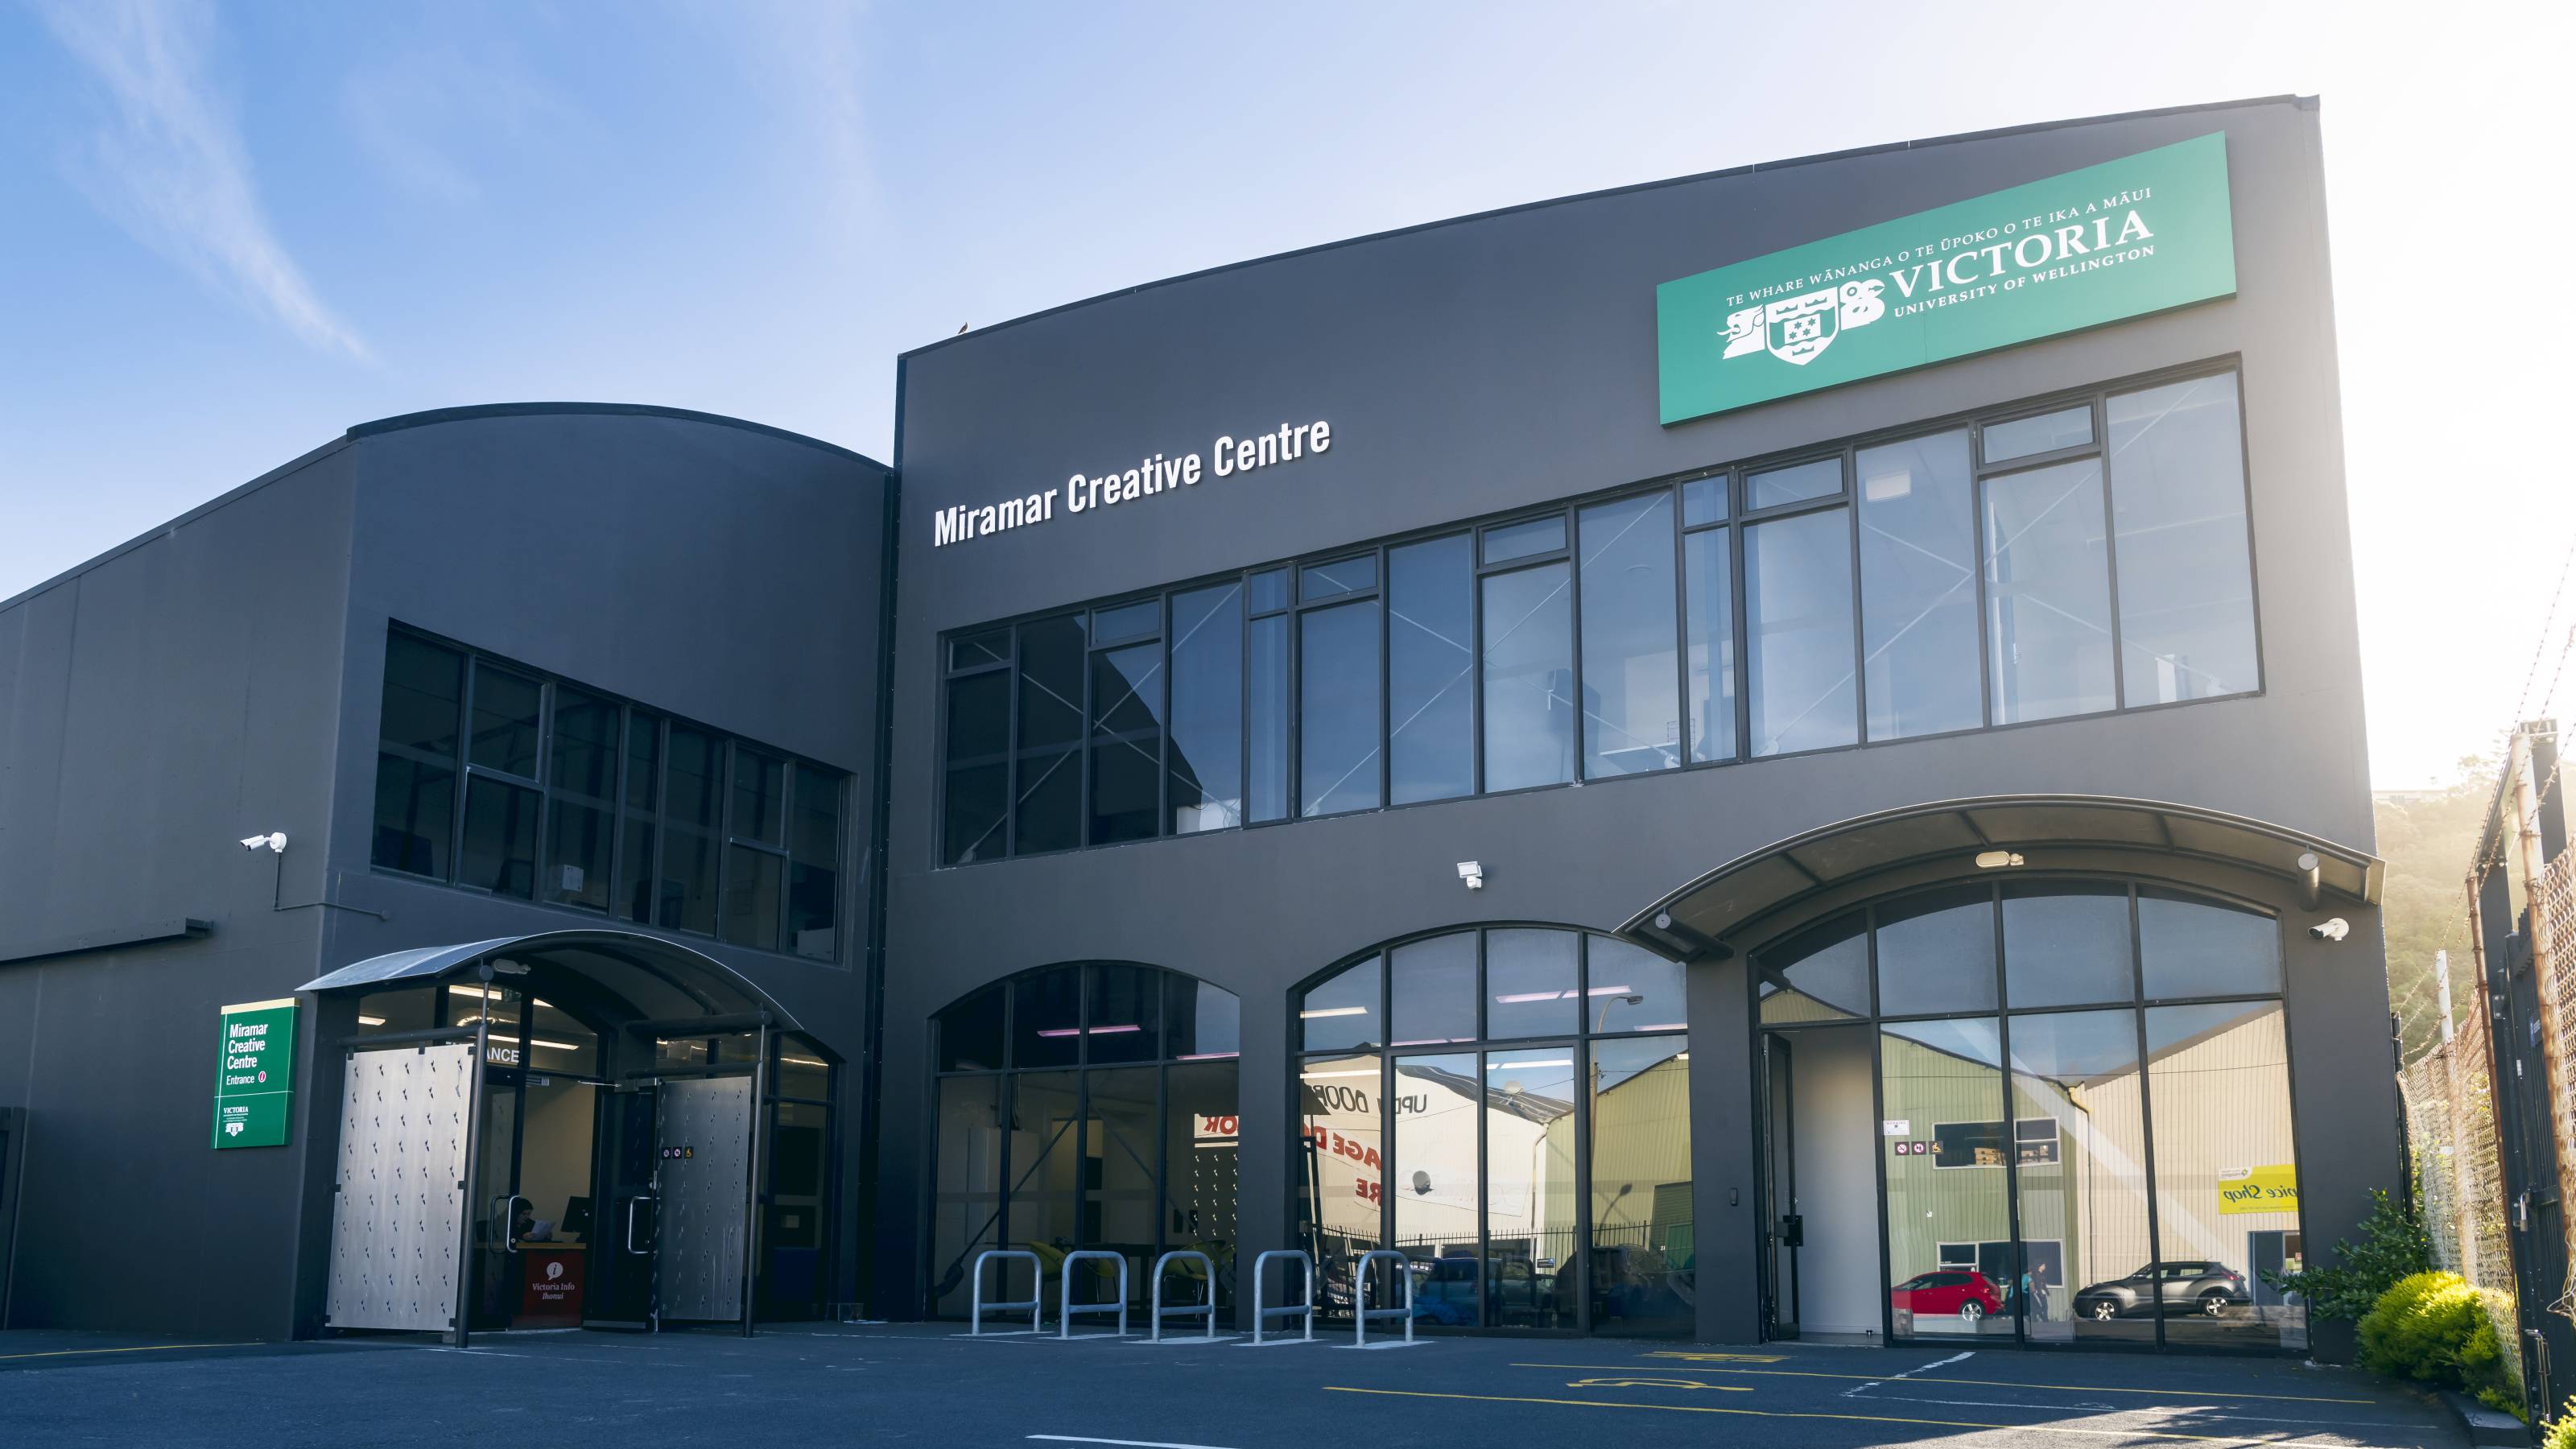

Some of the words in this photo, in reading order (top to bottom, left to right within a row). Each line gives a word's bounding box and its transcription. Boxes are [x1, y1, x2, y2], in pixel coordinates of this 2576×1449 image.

[1726, 295, 1744, 307] TE
[1748, 279, 1804, 300] WHARE
[1810, 256, 1893, 285] WĀNANGA
[1898, 250, 1909, 262] O
[1915, 244, 1934, 258] TE
[1940, 228, 1998, 251] ŪPOKO
[2004, 223, 2016, 234] O
[2022, 216, 2042, 229] TE
[2049, 207, 2079, 223] IKA
[2086, 203, 2097, 214] A
[2103, 188, 2152, 209] MĀUI
[1889, 209, 2154, 298] VICTORIA
[1894, 283, 1997, 317] UNIVERSITY
[2004, 277, 2026, 291] OF
[2033, 245, 2155, 283] WELLINGTON
[935, 488, 1058, 547] Miramar
[1067, 452, 1202, 514] Creative
[1214, 419, 1331, 477] Centre
[229, 1023, 269, 1038] Miramar
[229, 1038, 266, 1054] Creative
[227, 1055, 258, 1070] Centre
[226, 1075, 255, 1085] Entrance
[223, 1106, 249, 1114] VICTORIA
[532, 1282, 559, 1290] Victoria
[561, 1282, 576, 1290] Info
